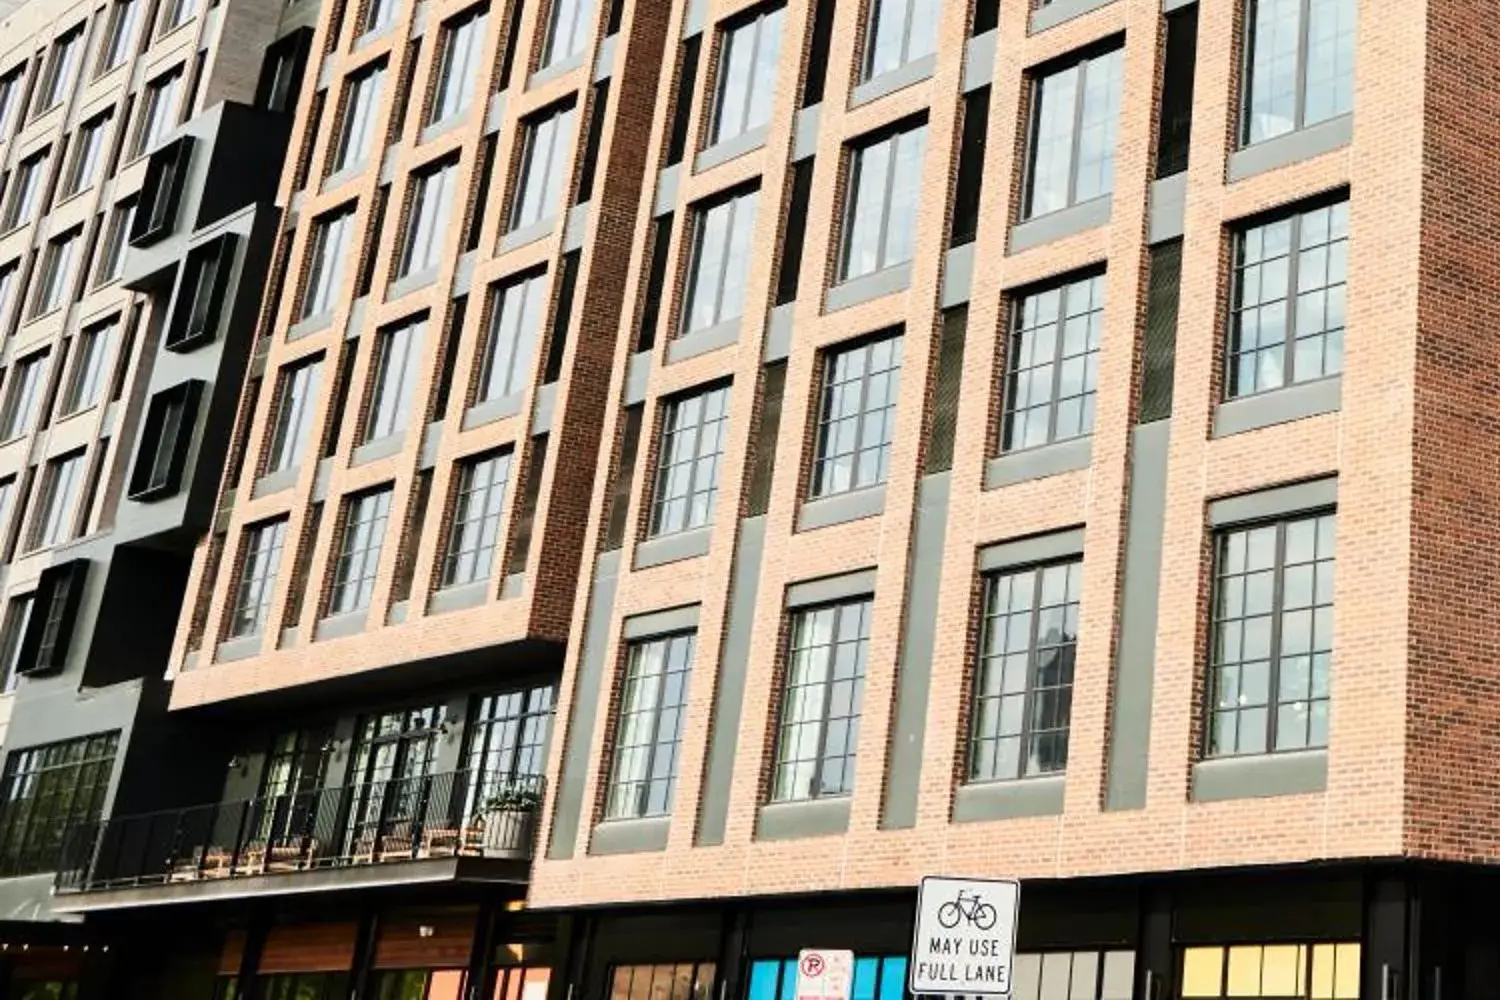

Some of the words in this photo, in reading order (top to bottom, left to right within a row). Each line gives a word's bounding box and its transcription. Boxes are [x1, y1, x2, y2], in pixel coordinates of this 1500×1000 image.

[929, 937, 962, 955] MAY
[969, 939, 999, 957] USE
[918, 962, 958, 981] FULL
[965, 964, 1005, 983] LANE
